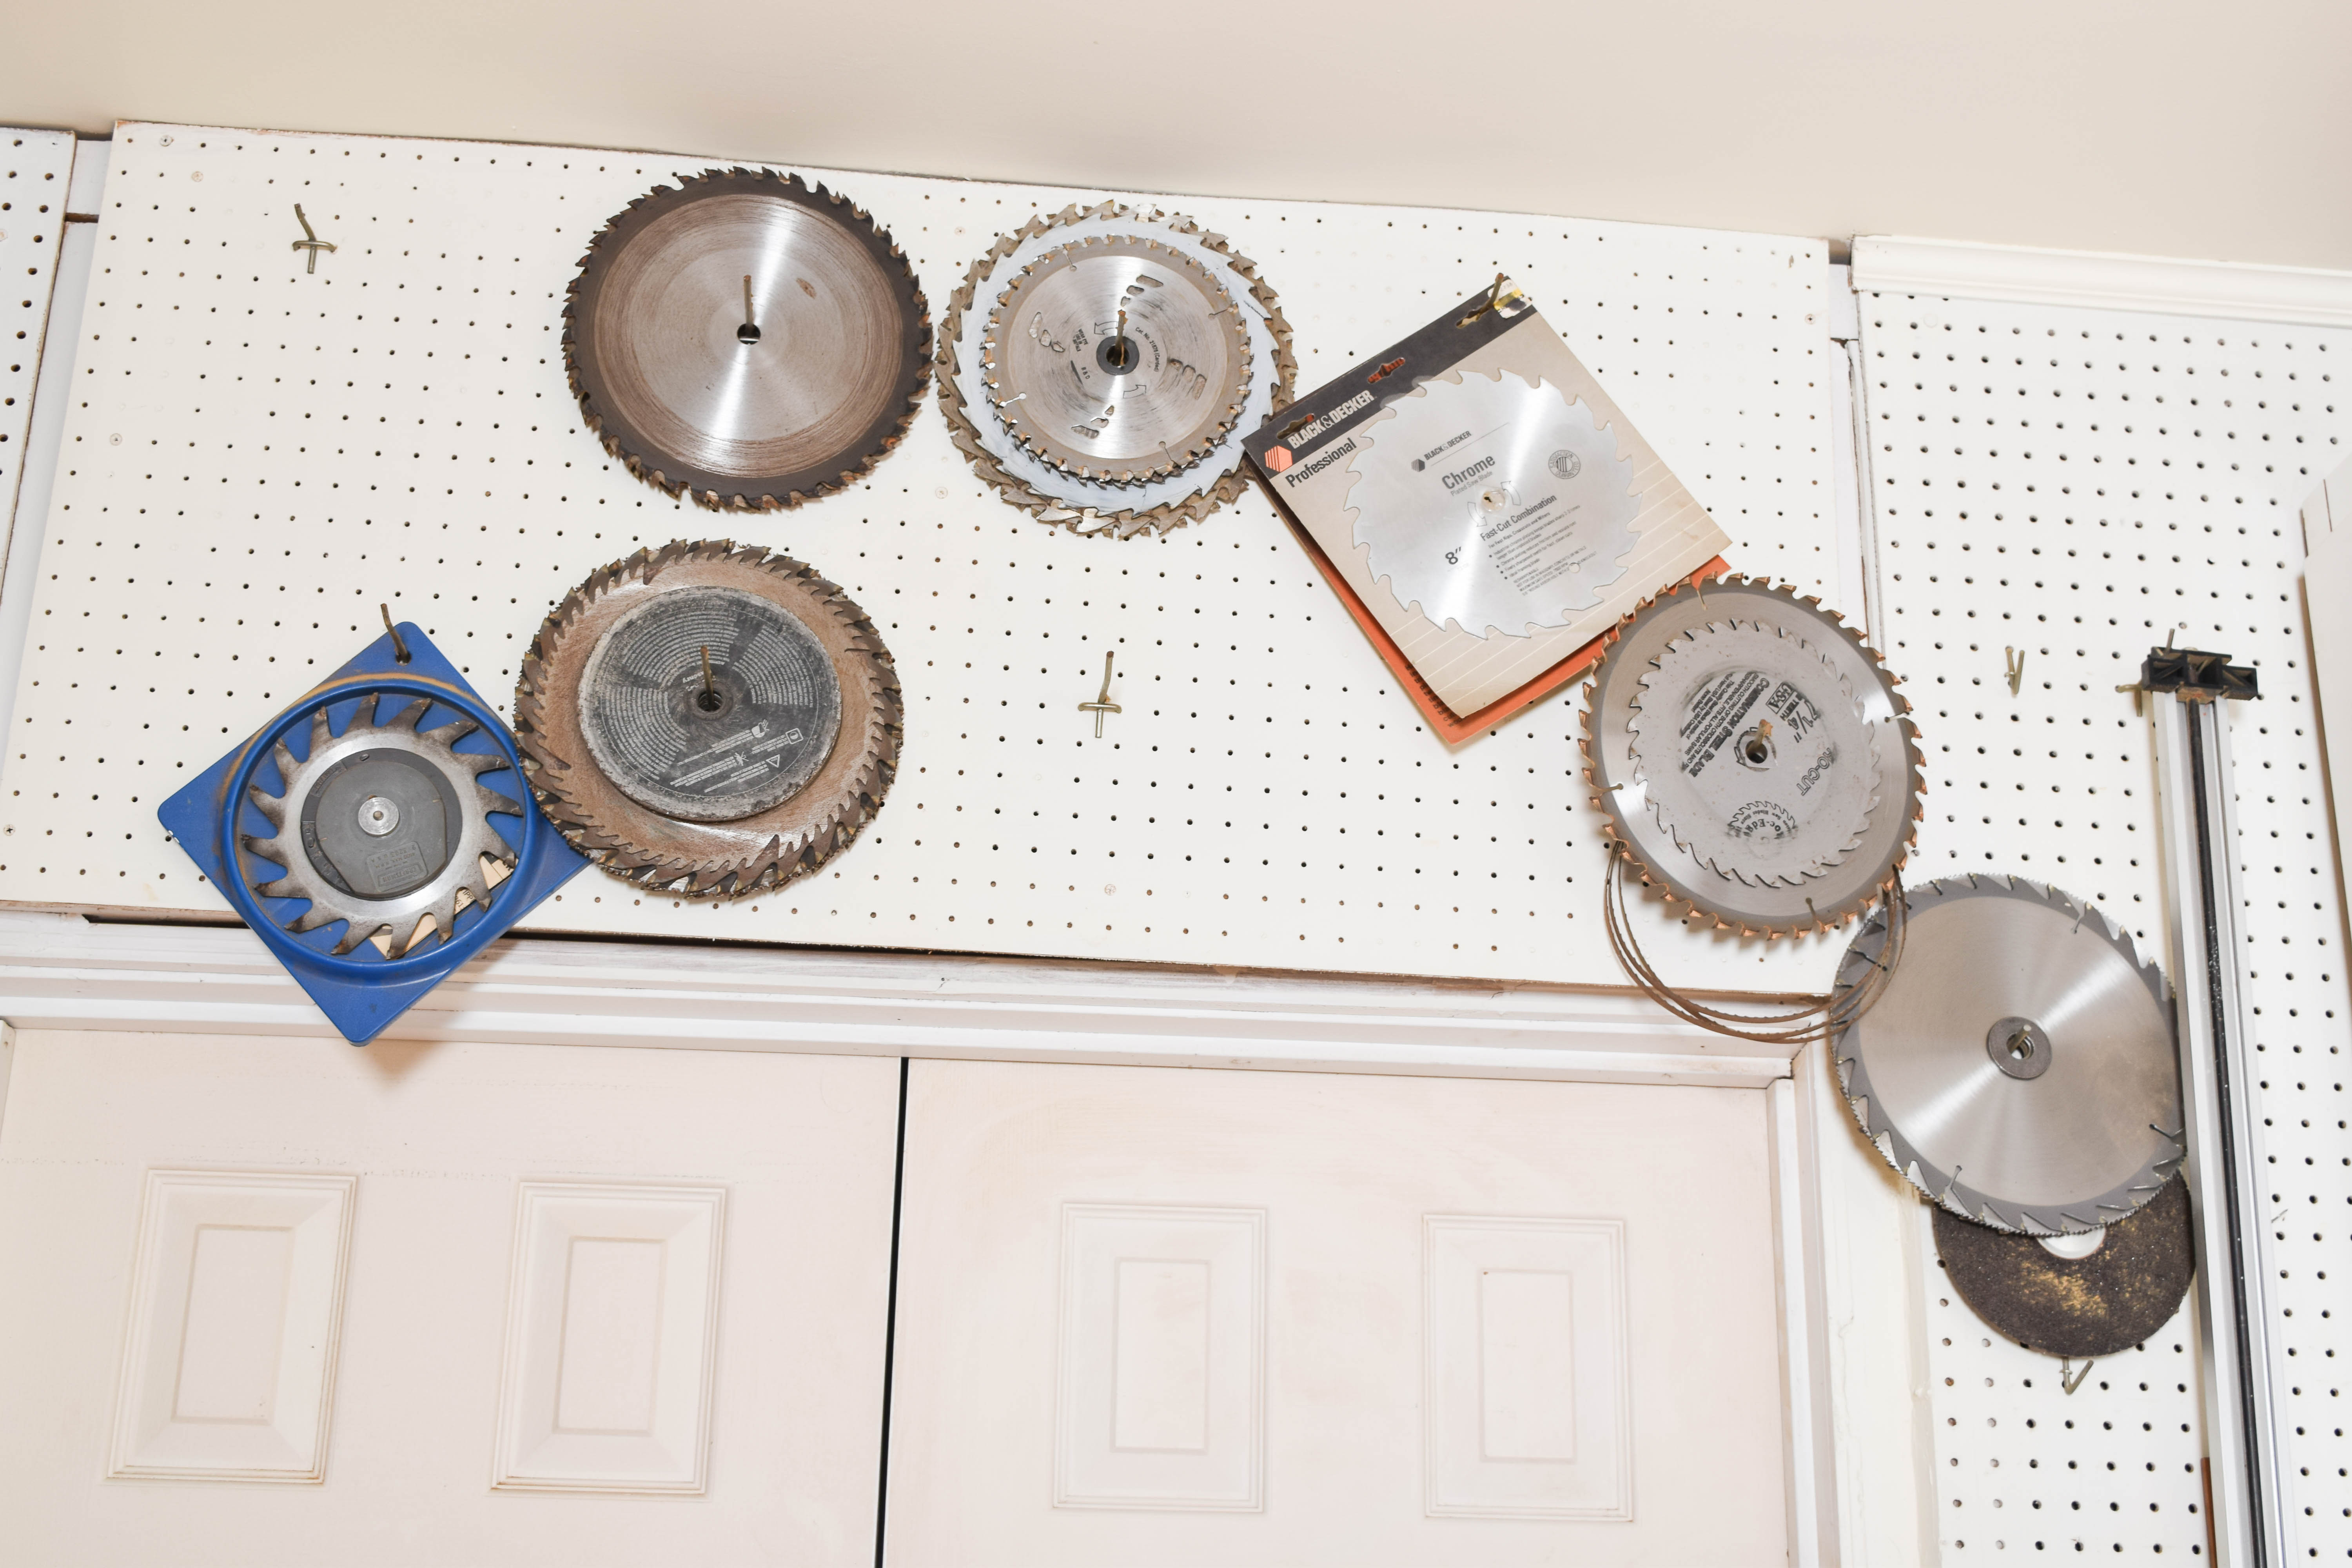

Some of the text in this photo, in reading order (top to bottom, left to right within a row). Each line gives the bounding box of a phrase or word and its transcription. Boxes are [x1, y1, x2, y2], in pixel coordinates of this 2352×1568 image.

[1287, 387, 1376, 450] BLACK&DECKER
[1285, 436, 1357, 488] Professional
[1423, 430, 1472, 461] BLACK&DECKER
[1441, 451, 1496, 491] Chrome
[1450, 470, 1493, 497] Plated Saw Blade
[1479, 492, 1558, 542] Fast-Cut Combination
